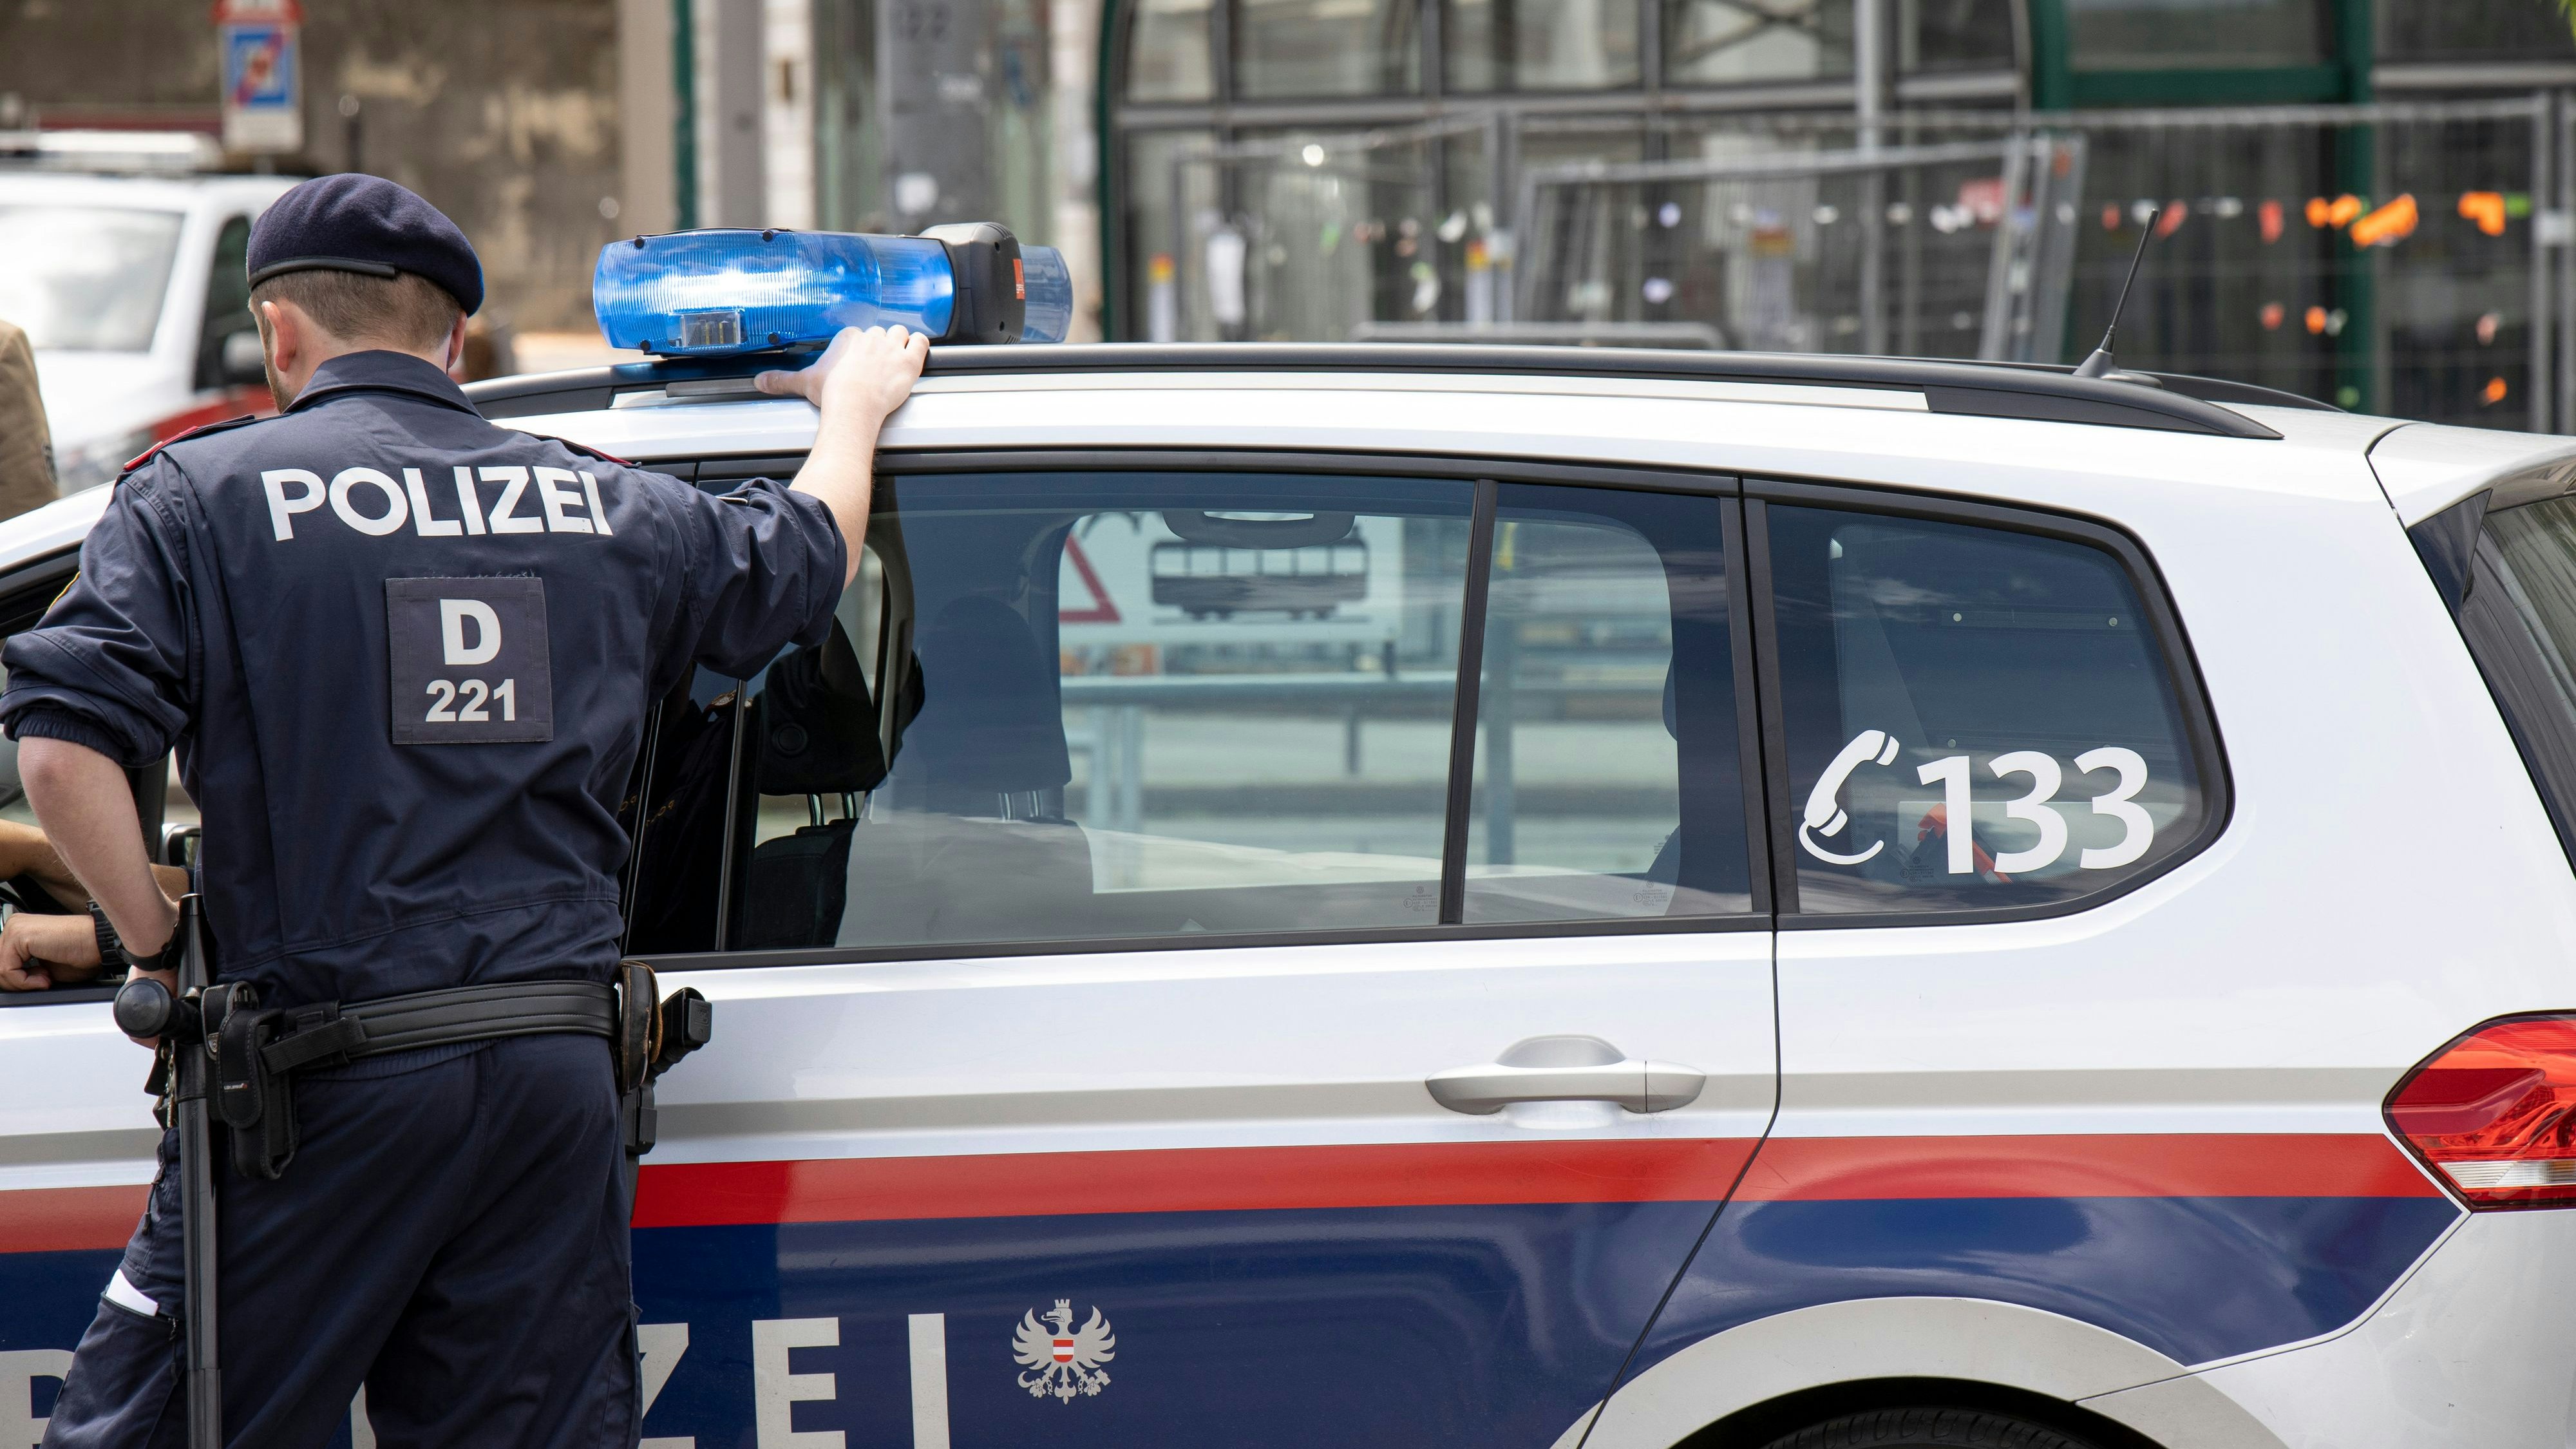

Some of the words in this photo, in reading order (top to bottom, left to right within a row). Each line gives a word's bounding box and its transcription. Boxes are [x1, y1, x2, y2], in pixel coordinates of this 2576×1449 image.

[261, 466, 613, 541] POLIZEI
[440, 600, 501, 665] D
[426, 679, 515, 722] 221
[1917, 748, 2154, 874] 133
